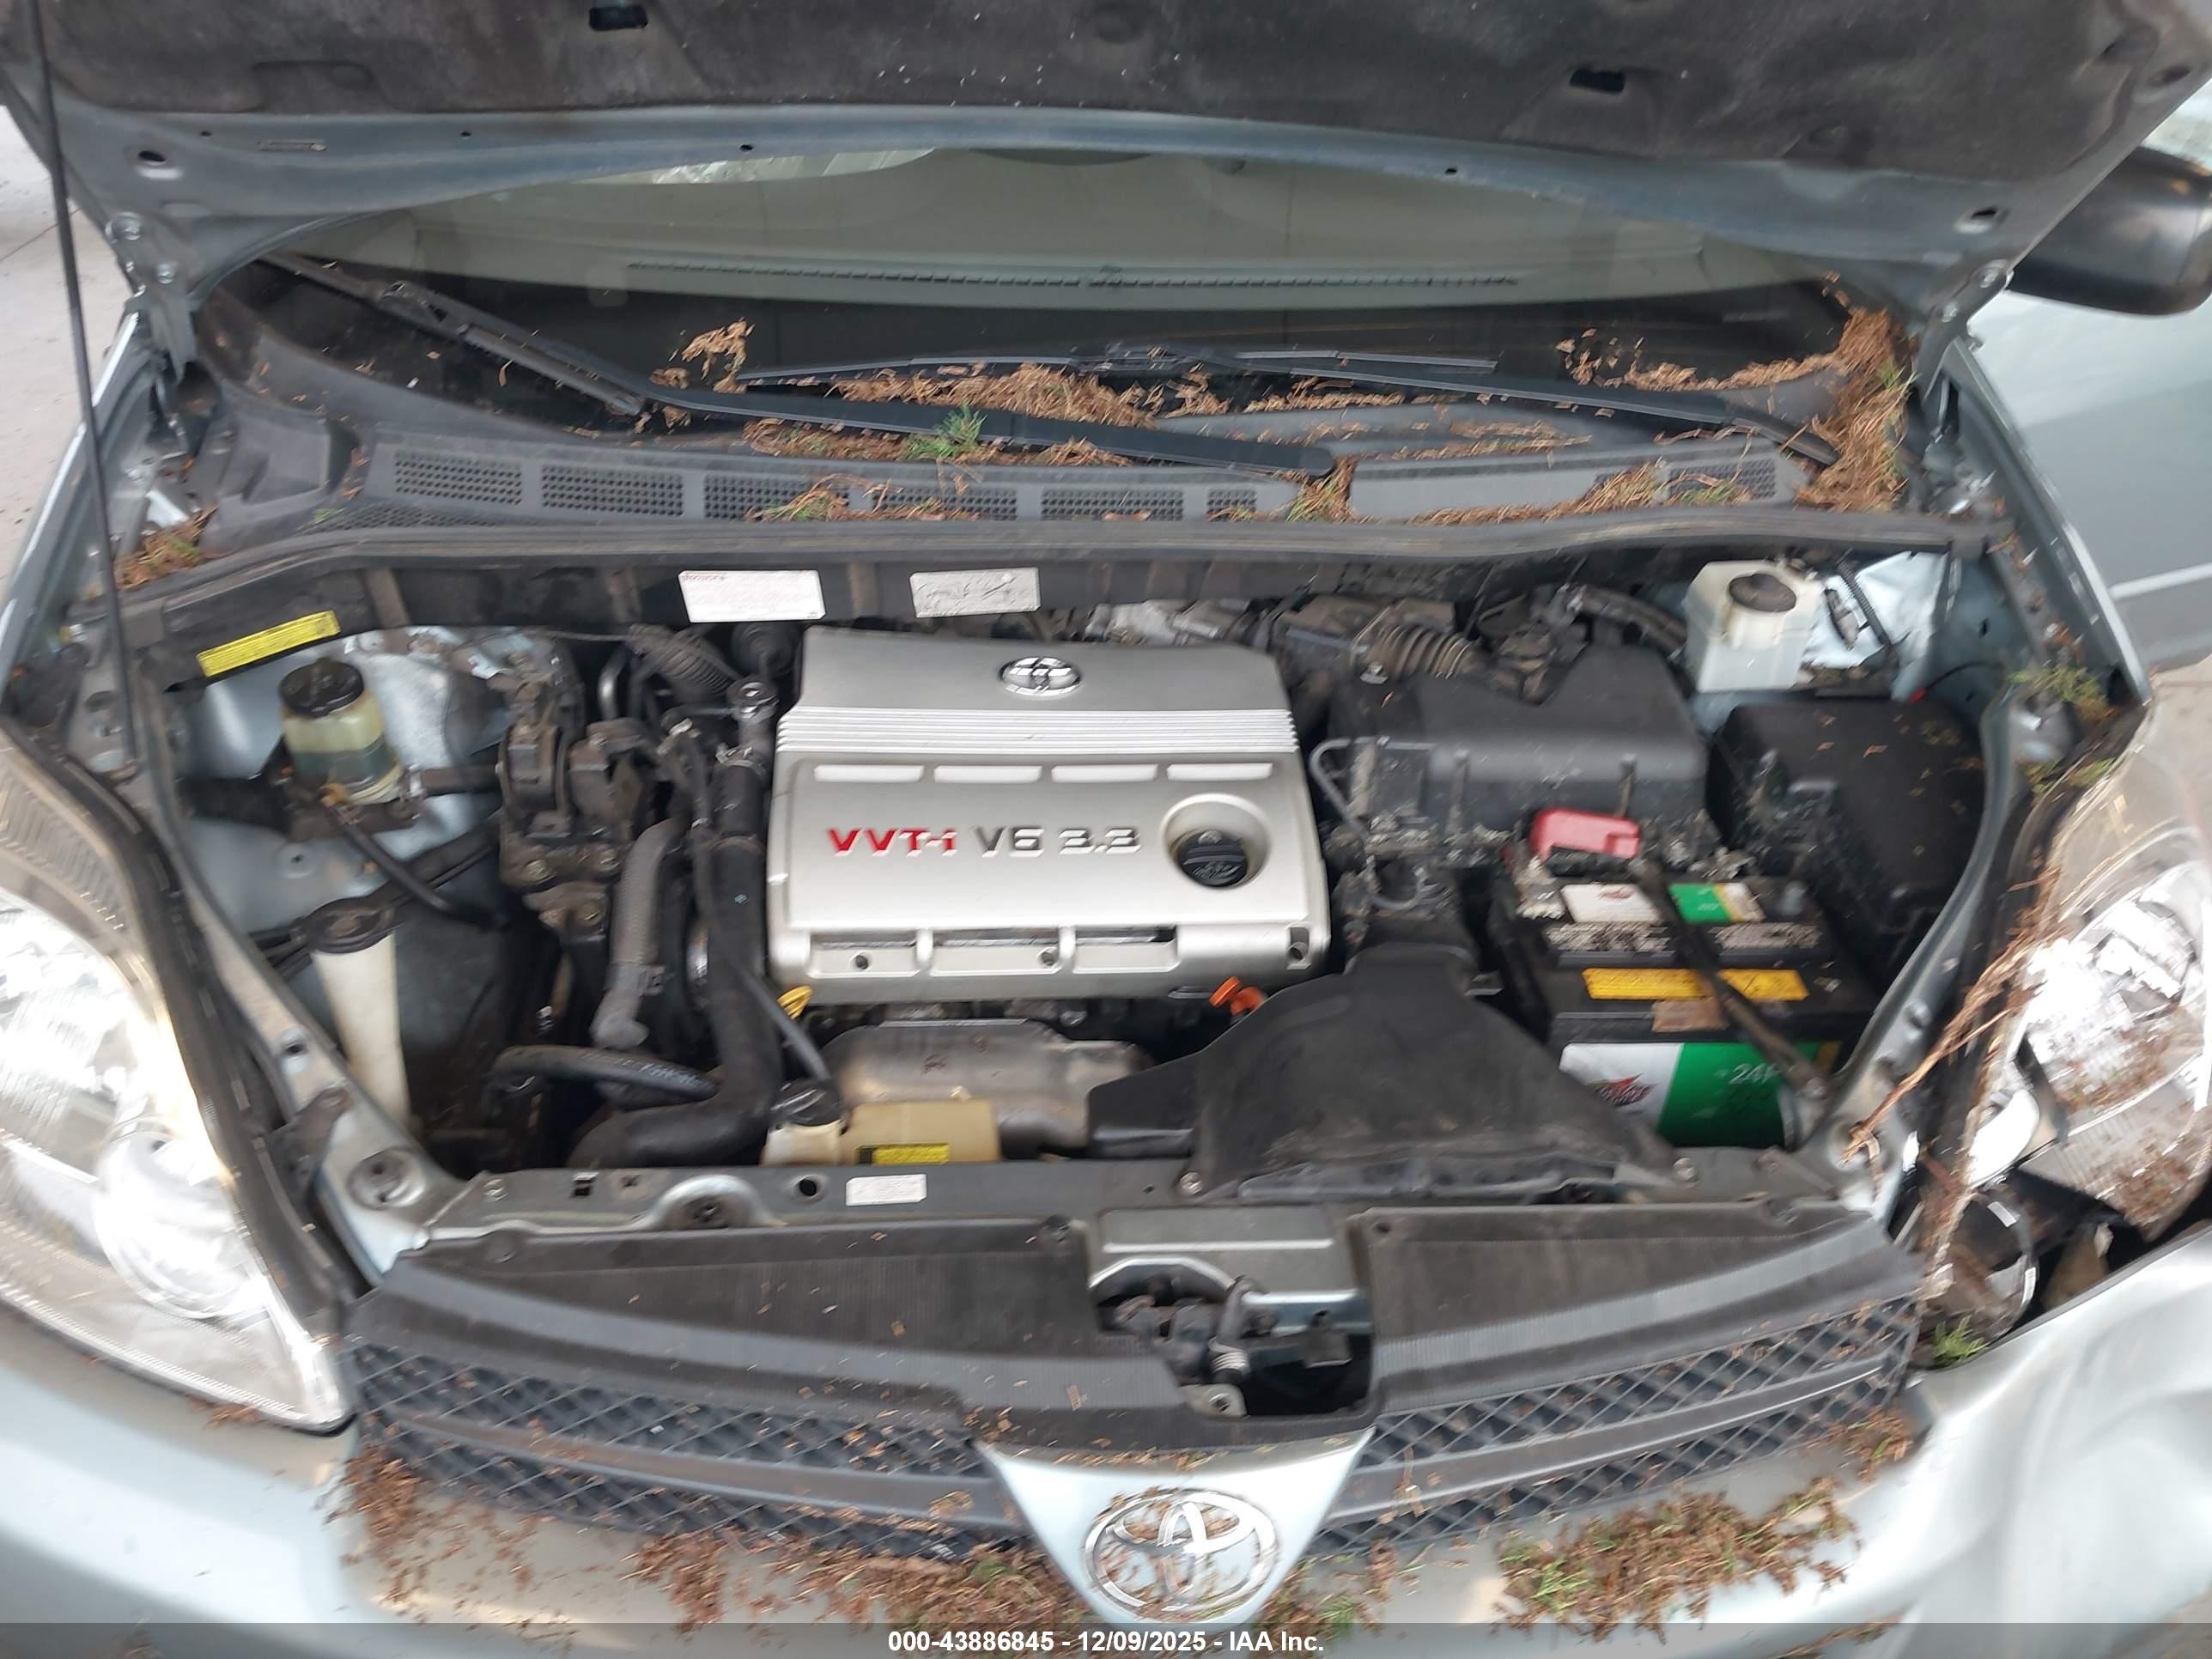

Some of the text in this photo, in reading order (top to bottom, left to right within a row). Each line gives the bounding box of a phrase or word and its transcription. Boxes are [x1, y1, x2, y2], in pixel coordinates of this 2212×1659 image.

[828, 827, 1141, 857] VVT-i V6 3.3
